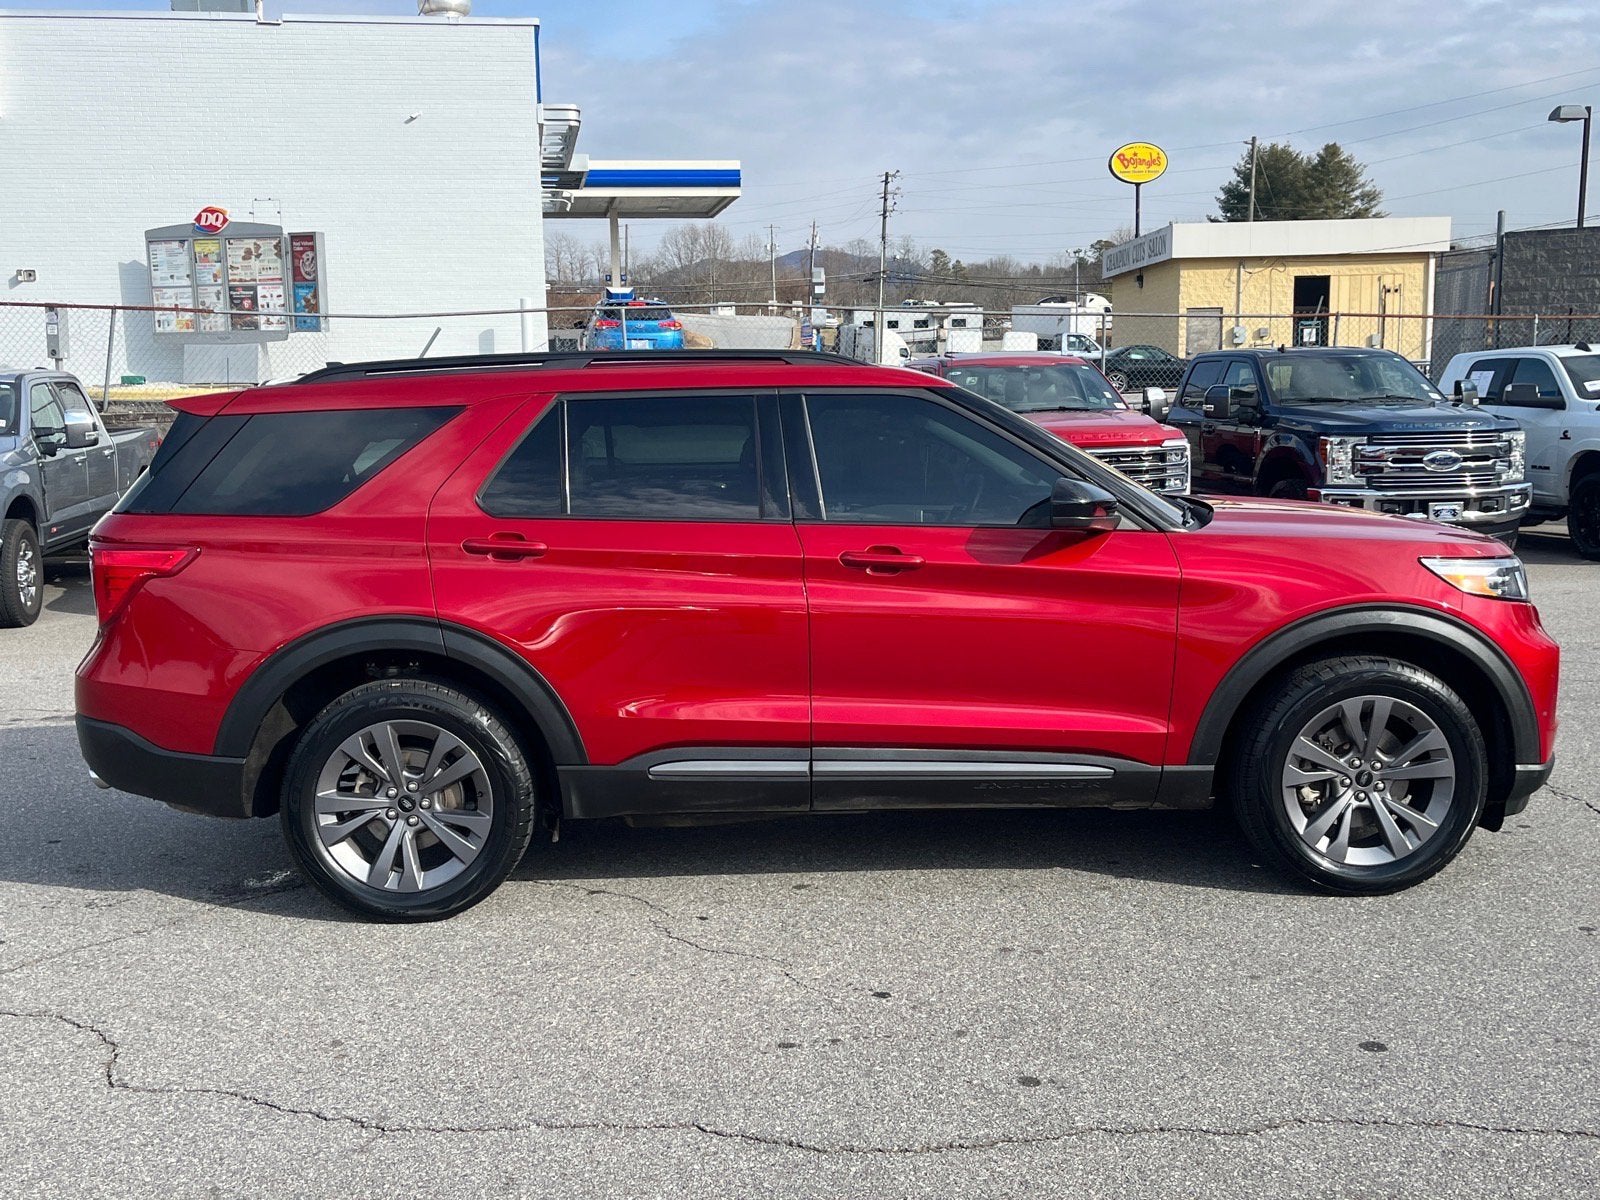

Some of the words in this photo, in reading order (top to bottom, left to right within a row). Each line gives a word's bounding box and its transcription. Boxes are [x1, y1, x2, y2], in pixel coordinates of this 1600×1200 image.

[200, 212, 223, 227] DQ
[1132, 241, 1146, 264] CUTS
[1148, 234, 1167, 259] SALON
[974, 782, 1100, 790] EXPLORER
